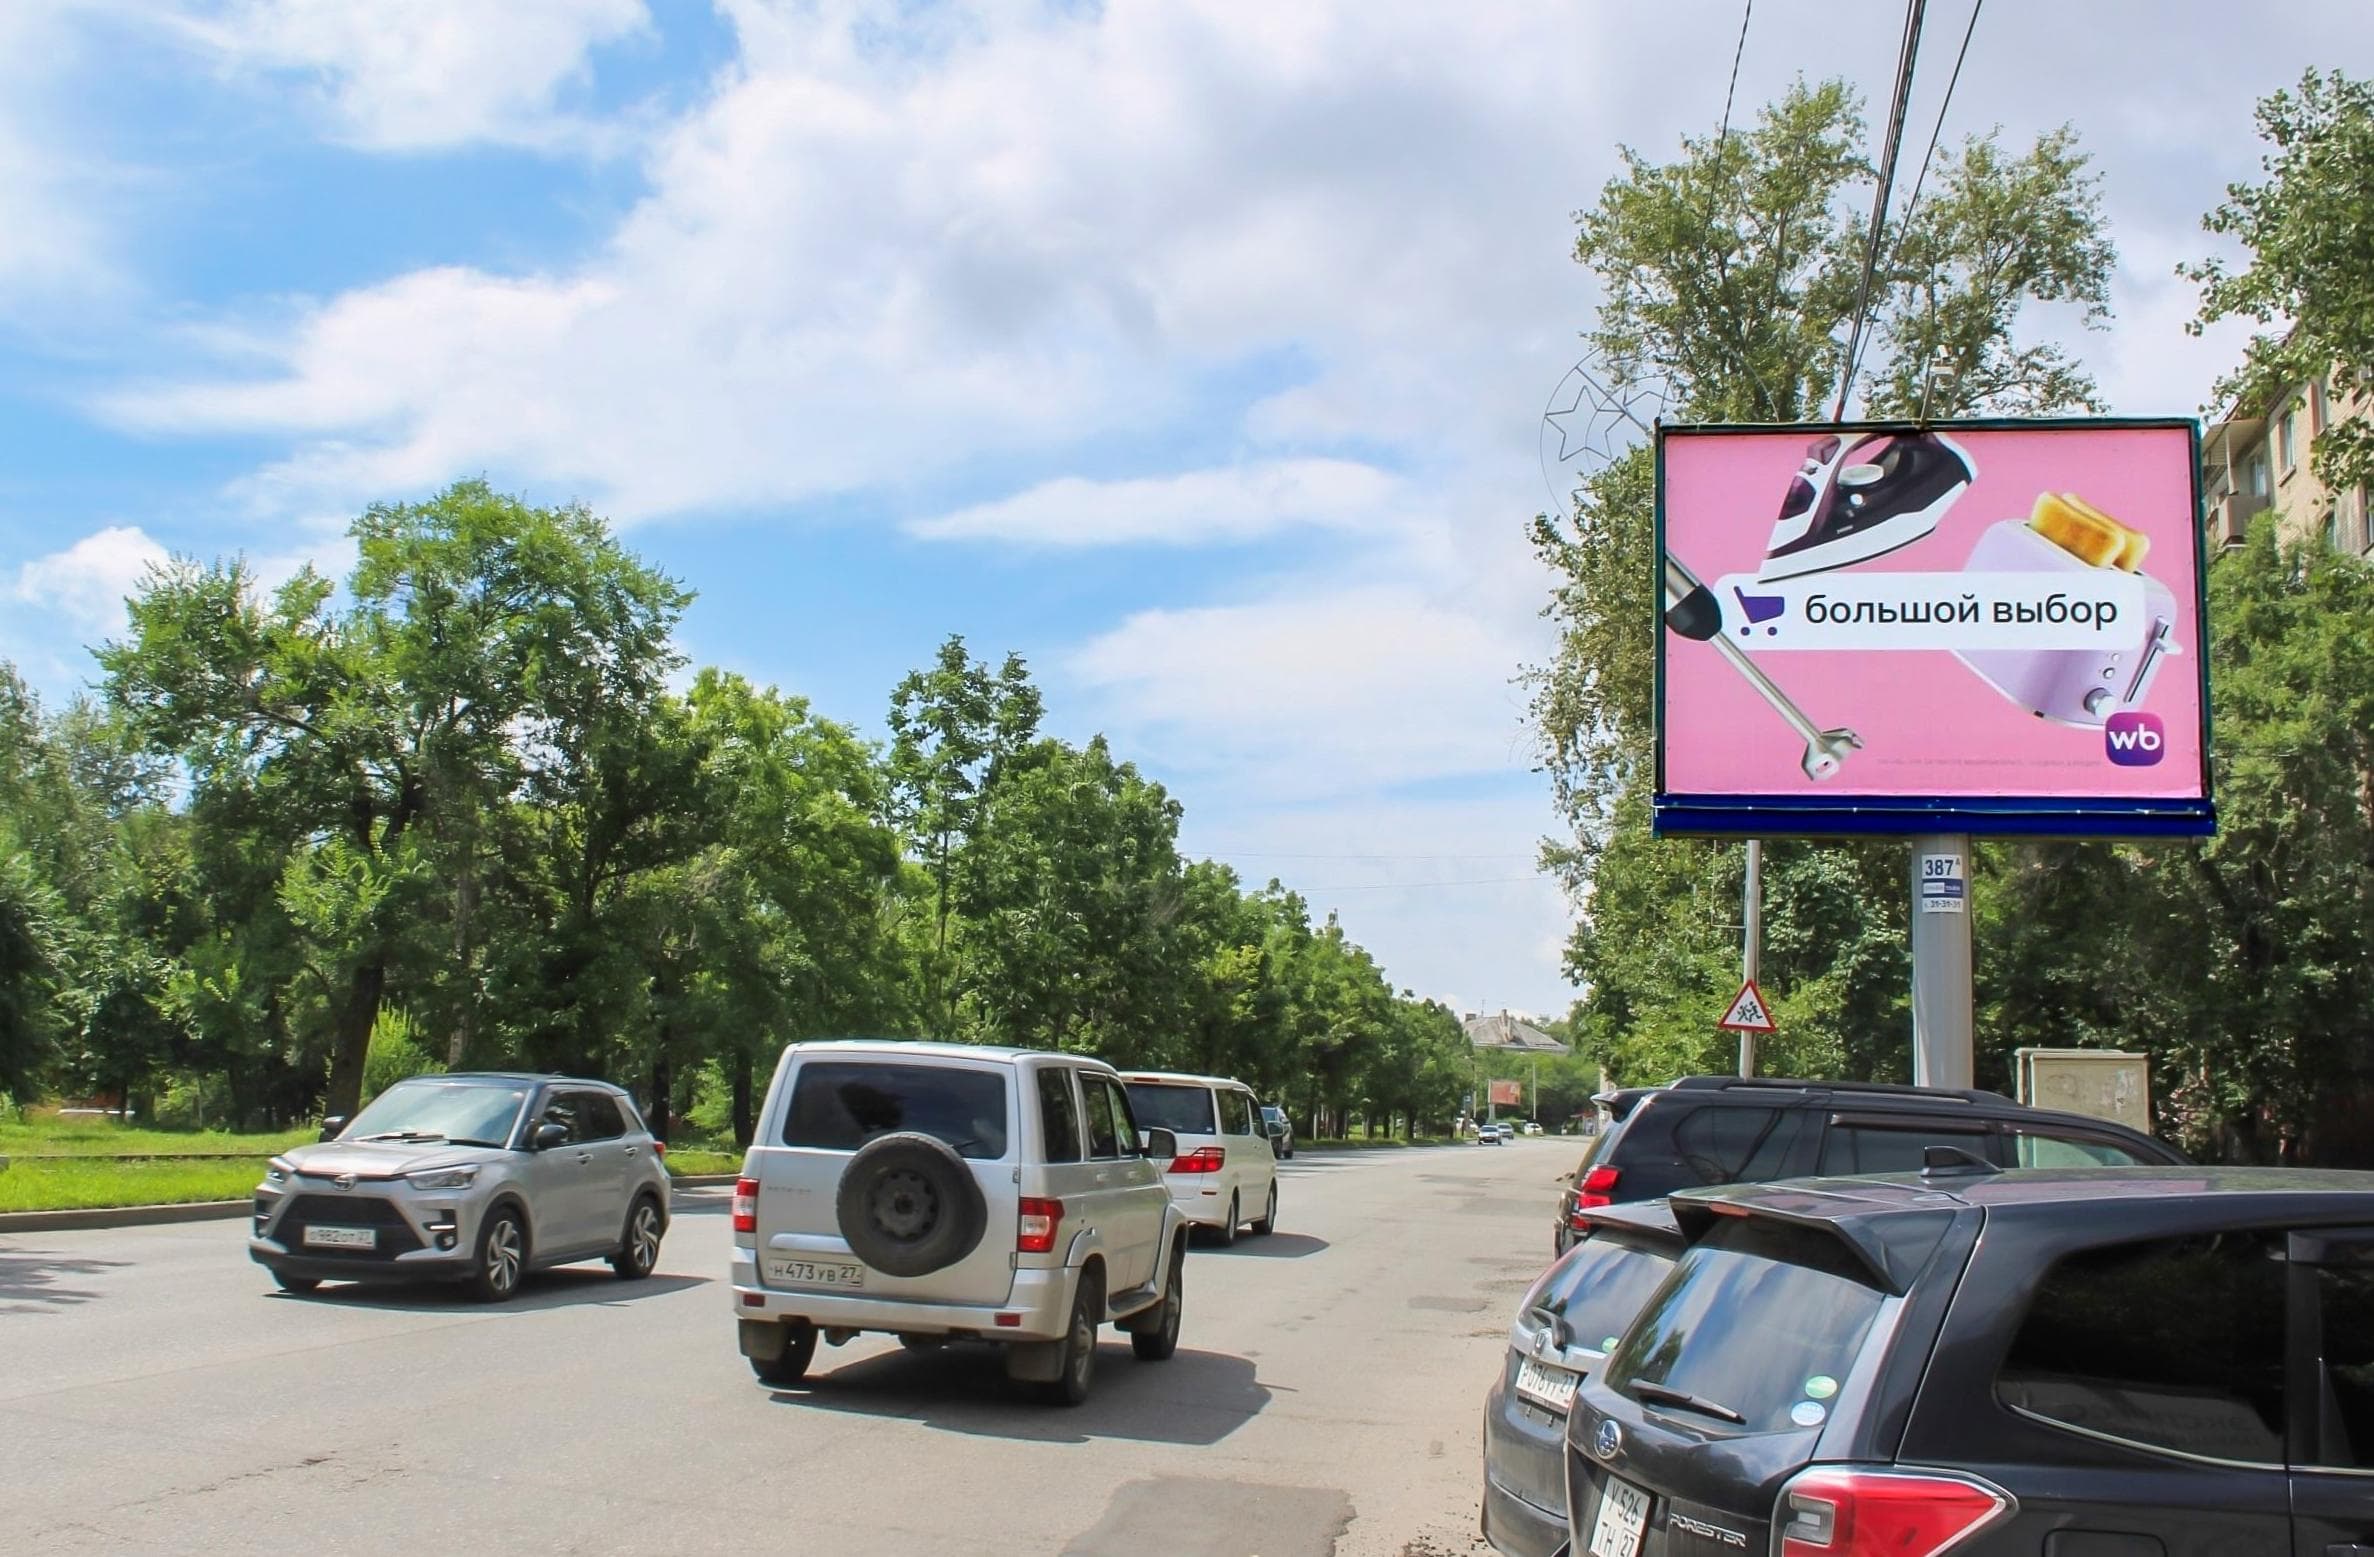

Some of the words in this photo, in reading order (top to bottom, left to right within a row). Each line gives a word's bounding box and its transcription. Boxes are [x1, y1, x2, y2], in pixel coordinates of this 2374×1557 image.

[1804, 594, 1979, 624] большой
[1993, 593, 2117, 631] выбор
[2108, 723, 2161, 751] wb
[1669, 1512, 1746, 1547] FORESTER
